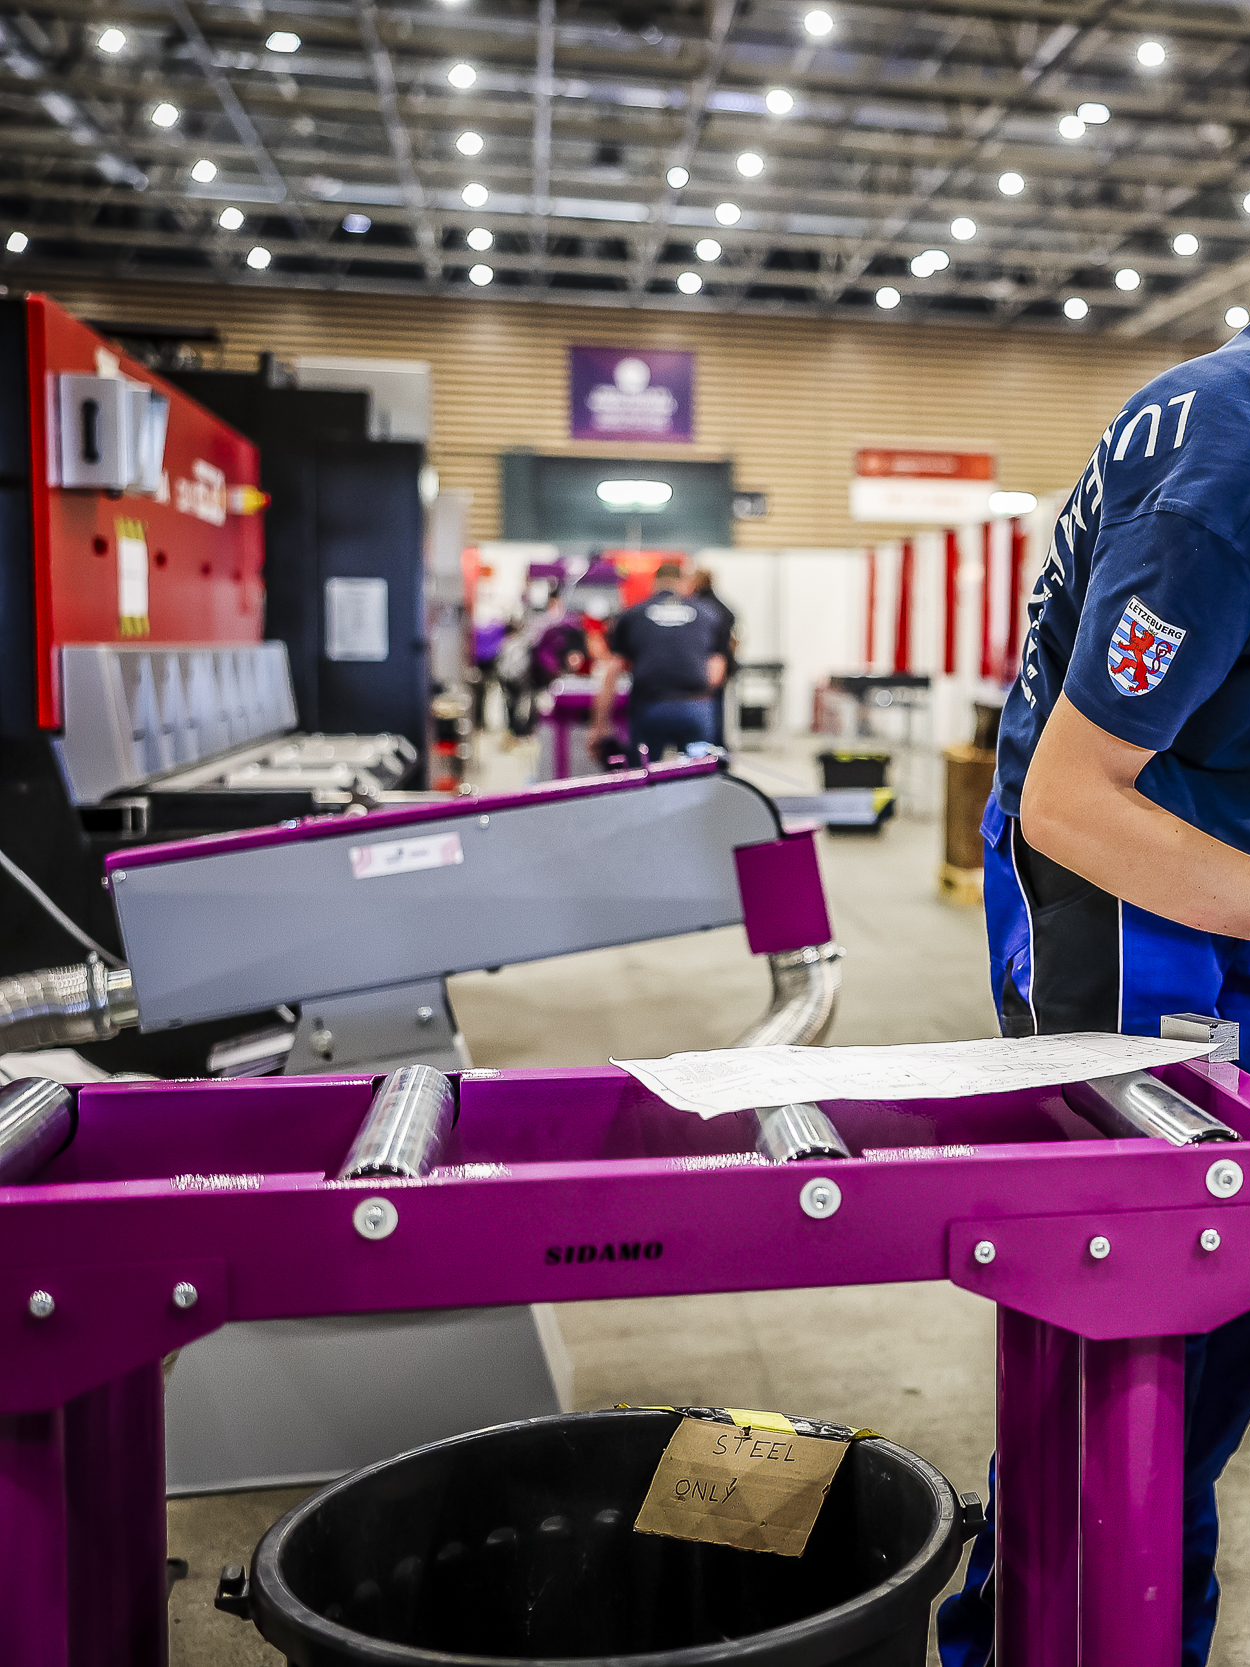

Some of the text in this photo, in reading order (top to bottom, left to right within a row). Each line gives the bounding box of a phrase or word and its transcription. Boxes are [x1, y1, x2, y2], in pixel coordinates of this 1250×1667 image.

[1128, 601, 1183, 640] LËTZEBUERG
[545, 1242, 663, 1265] SIDAMO
[713, 1434, 796, 1462] STEEL
[675, 1478, 738, 1504] ONLY
